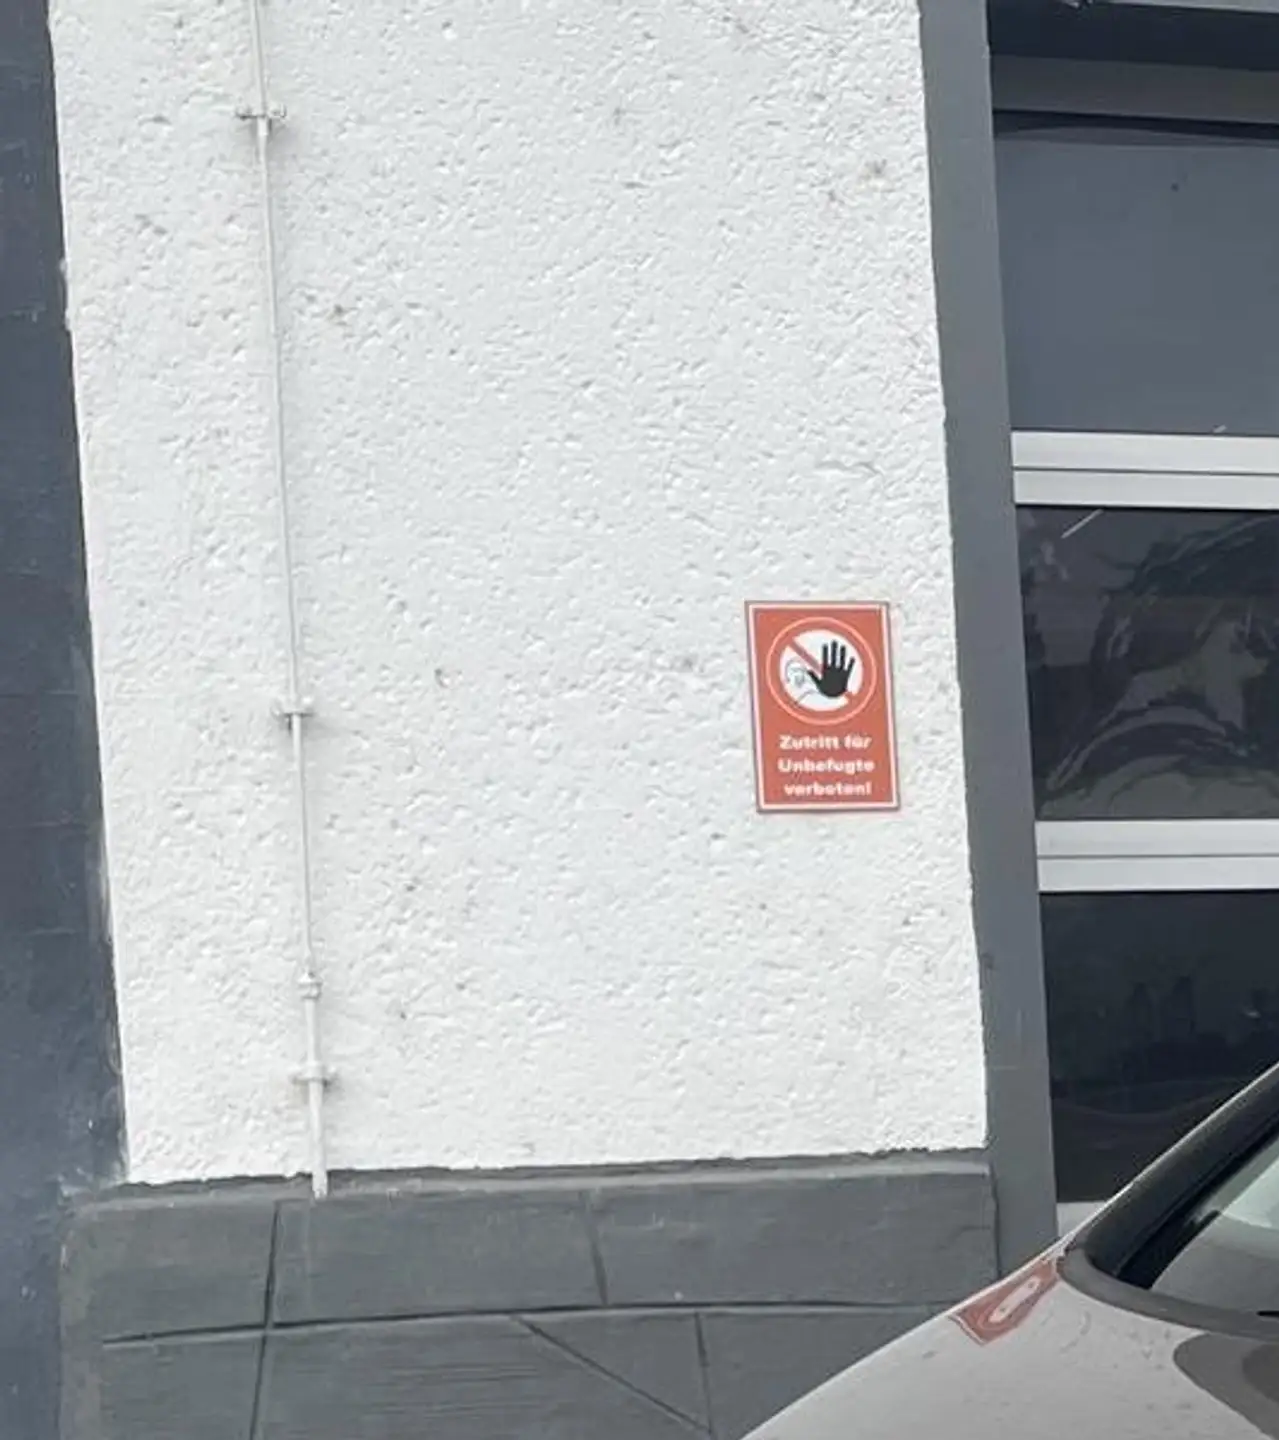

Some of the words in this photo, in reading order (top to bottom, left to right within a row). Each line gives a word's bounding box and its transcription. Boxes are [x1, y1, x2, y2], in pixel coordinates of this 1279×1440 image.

[779, 734, 839, 750] Zutritt
[844, 734, 872, 750] für
[778, 758, 876, 775] Unbefugte
[784, 780, 872, 797] verboten!
